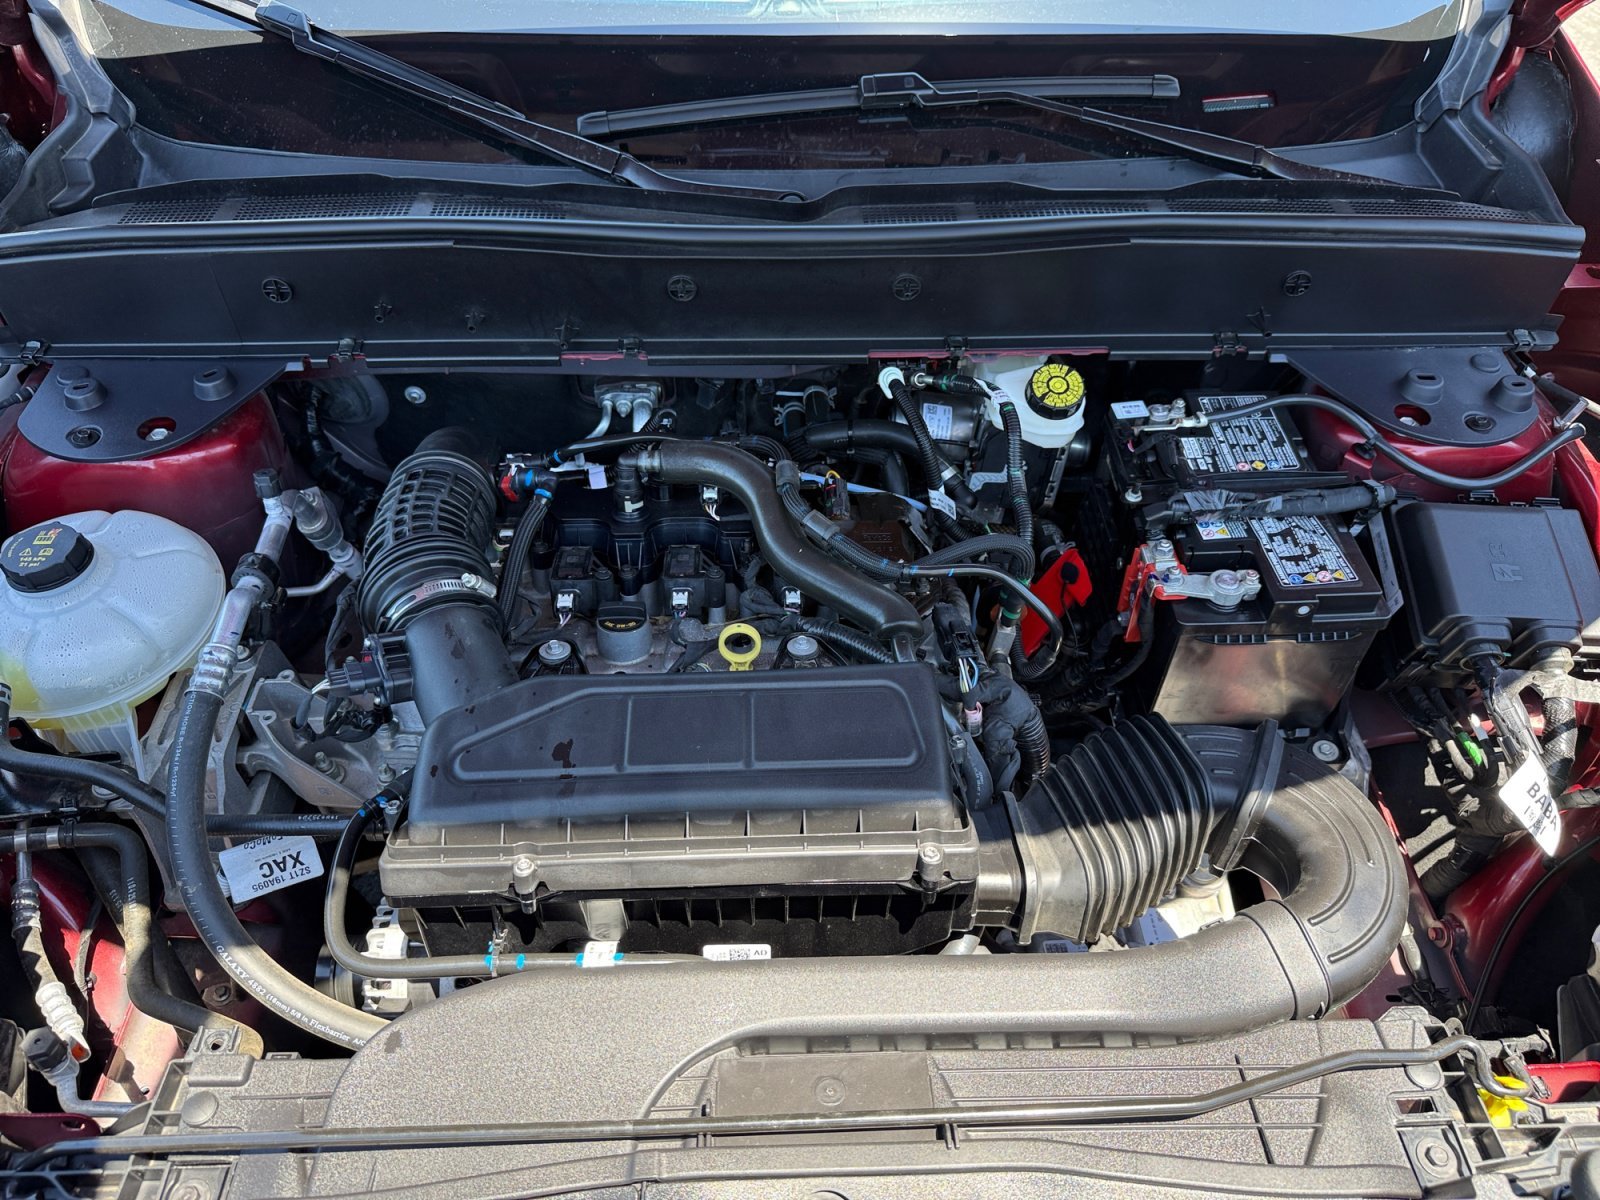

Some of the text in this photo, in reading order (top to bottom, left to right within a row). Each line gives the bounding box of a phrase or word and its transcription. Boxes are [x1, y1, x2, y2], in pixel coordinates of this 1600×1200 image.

[180, 715, 190, 735] HOSE
[1526, 781, 1558, 832] BABA
[259, 850, 305, 879] XAC
[251, 866, 312, 893] SZ1T 19A095
[216, 945, 250, 980] GALAXY
[248, 978, 266, 996] 4882
[309, 1018, 351, 1042] Flexbarrier
